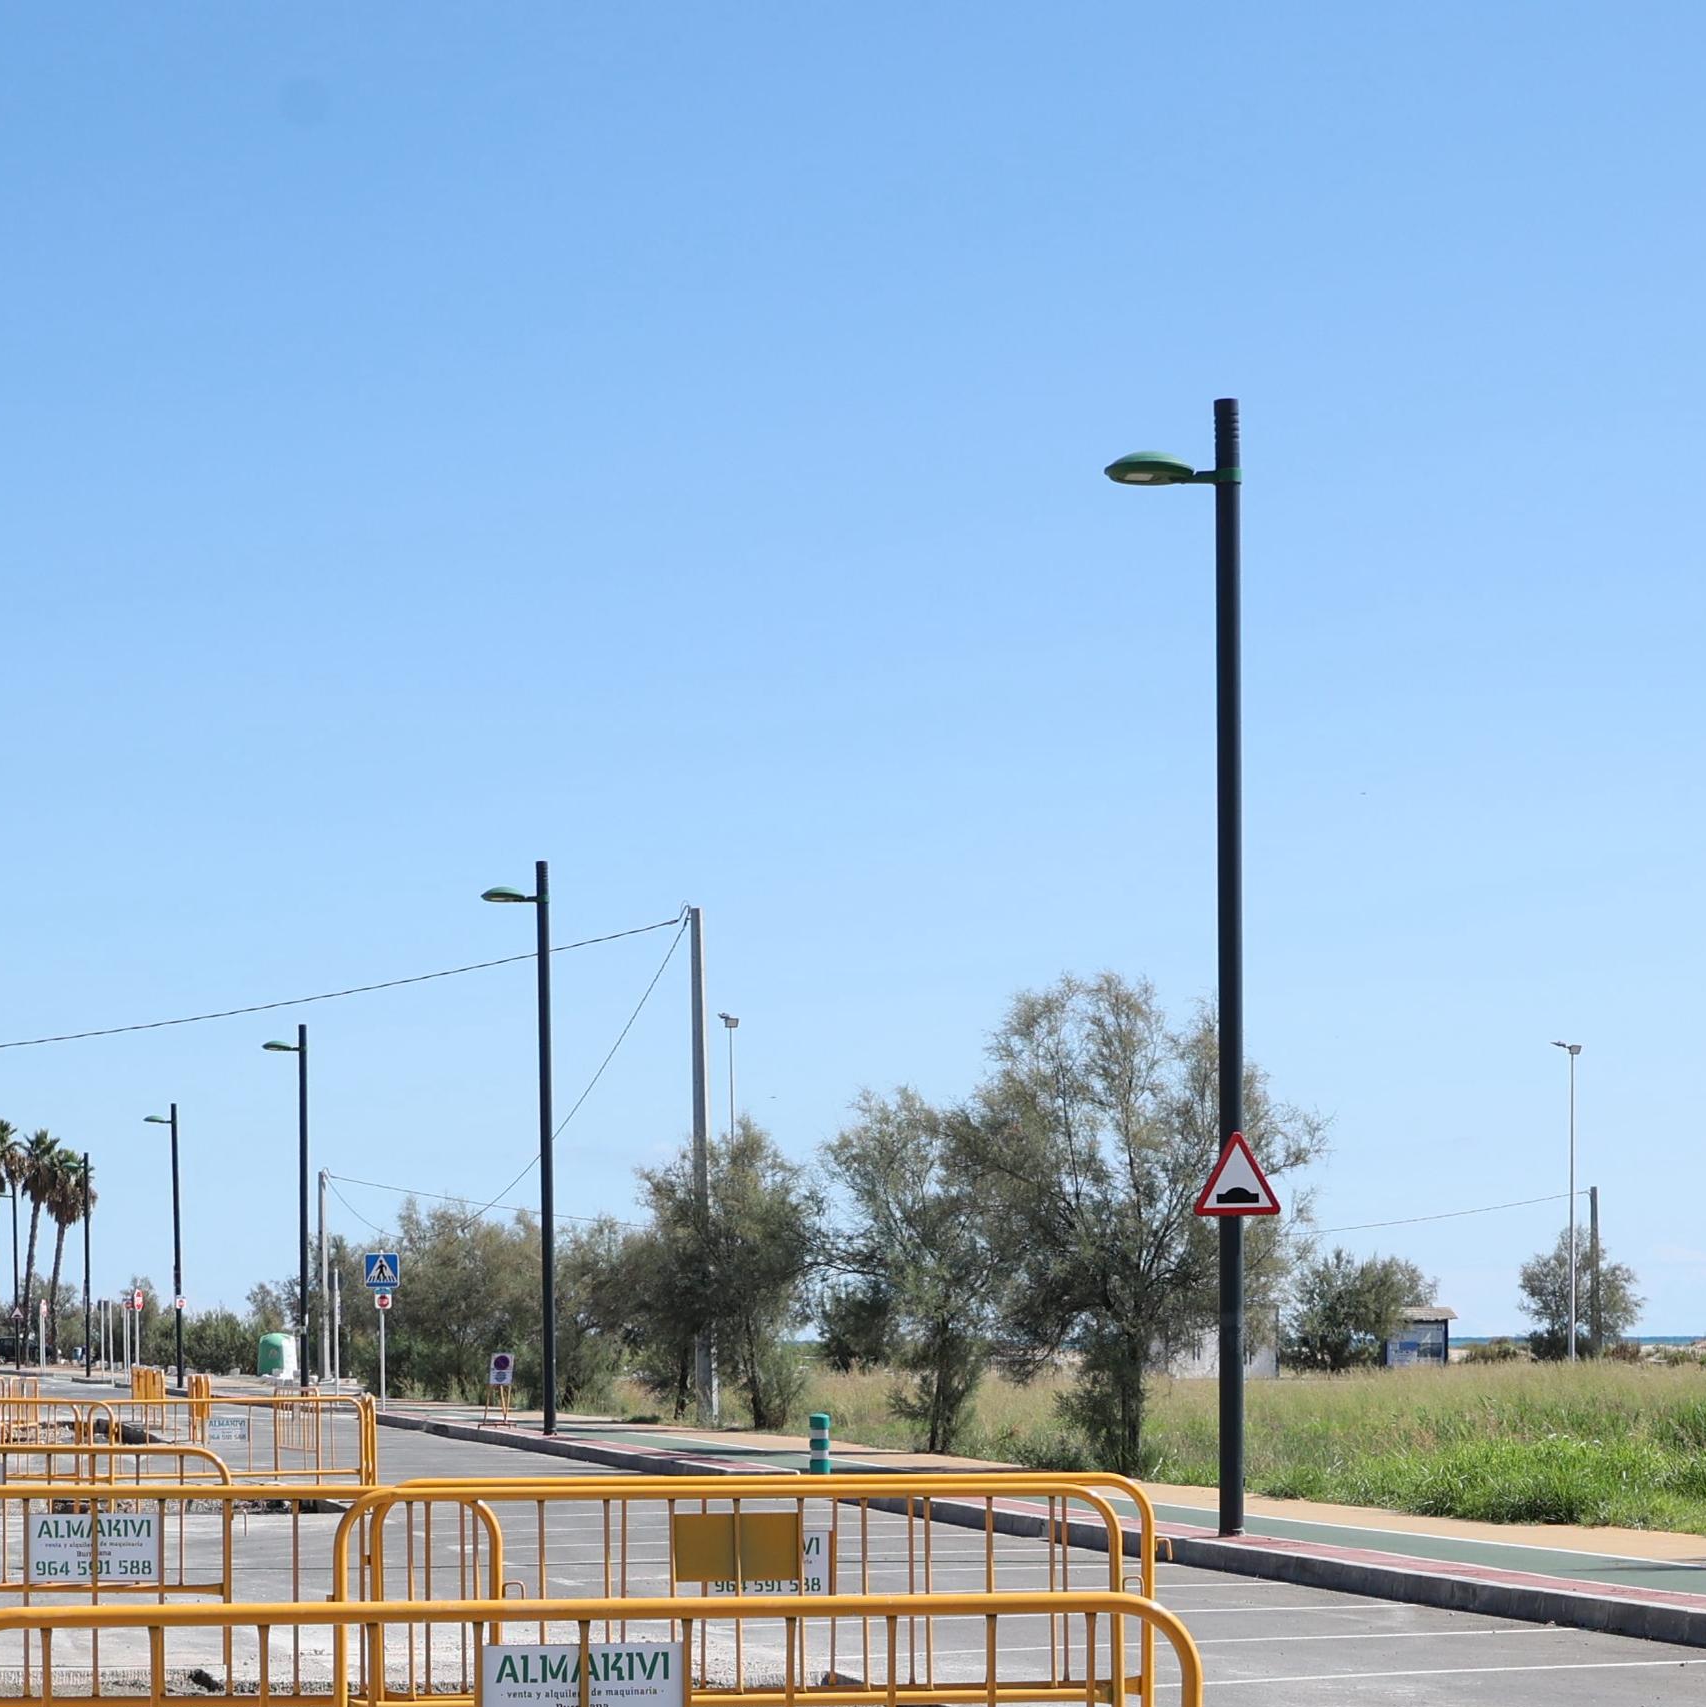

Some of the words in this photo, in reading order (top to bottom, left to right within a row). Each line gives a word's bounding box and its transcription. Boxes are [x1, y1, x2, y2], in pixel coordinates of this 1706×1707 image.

[37, 1519, 152, 1539] ALMAKIVI
[76, 1550, 112, 1558] Burrana
[36, 1561, 70, 1576] 964
[119, 1560, 153, 1575] 588
[495, 1651, 670, 1684] ALMAKIVI
[507, 1690, 532, 1699] venta
[536, 1691, 542, 1700] y
[591, 1687, 602, 1696] de
[605, 1687, 658, 1698] maquinaria
